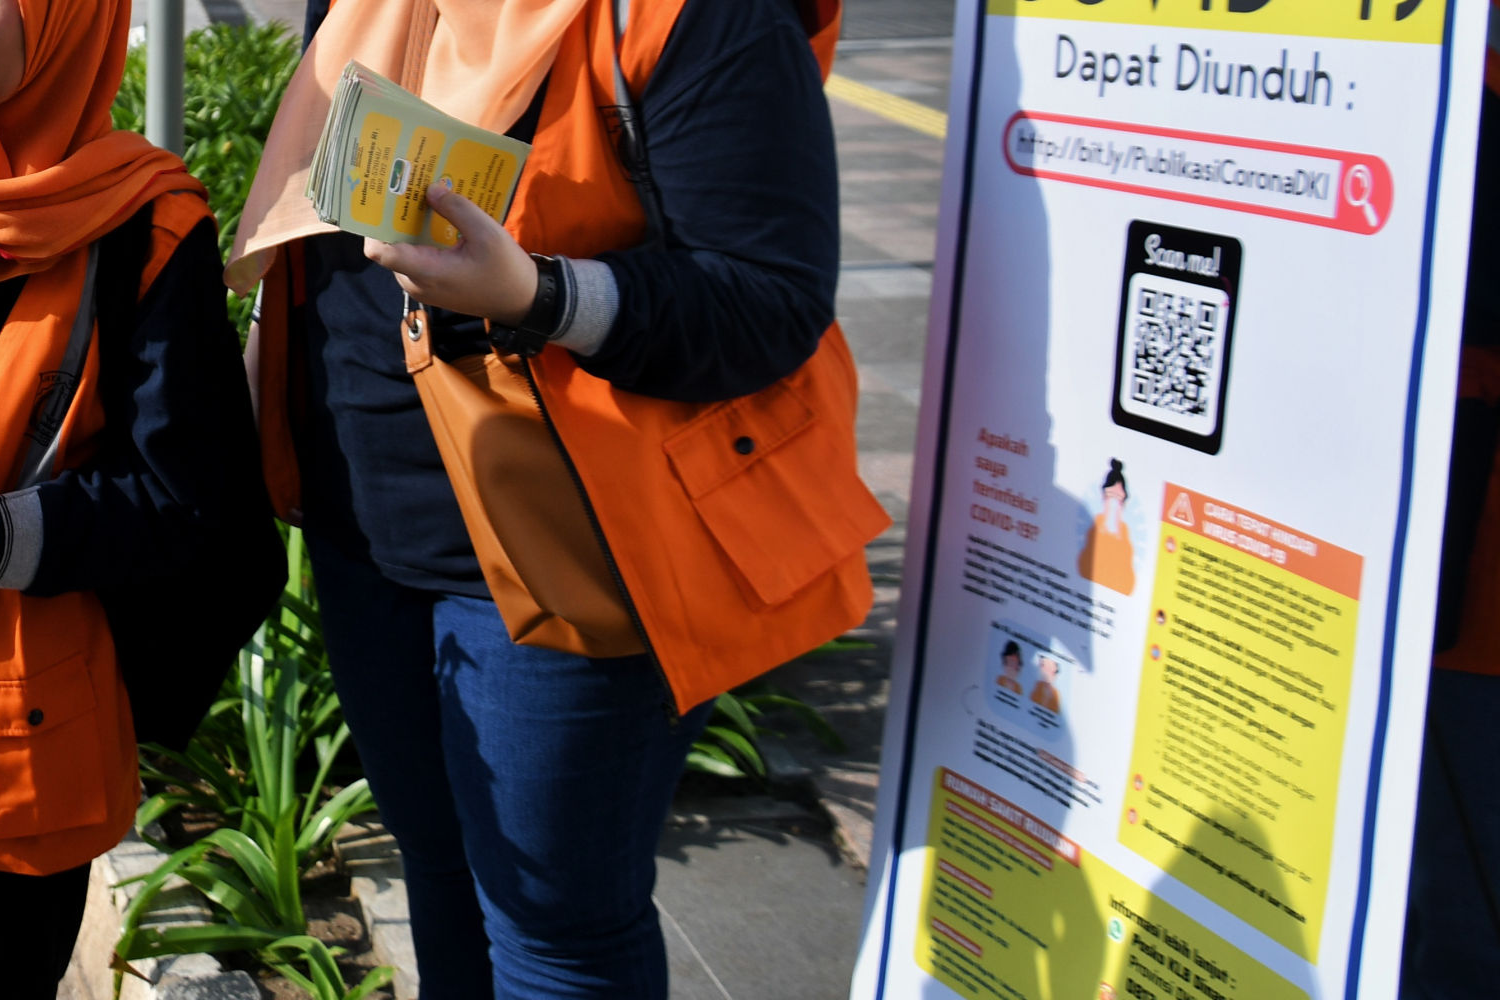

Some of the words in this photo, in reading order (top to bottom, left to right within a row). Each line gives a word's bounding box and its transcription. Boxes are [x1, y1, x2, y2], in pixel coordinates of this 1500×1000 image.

[1055, 34, 1159, 97] Dapat
[1174, 43, 1331, 108] Diunduh
[1143, 234, 1185, 270] Scan
[1109, 894, 1162, 938] Informasi
[1132, 933, 1166, 966] Posko
